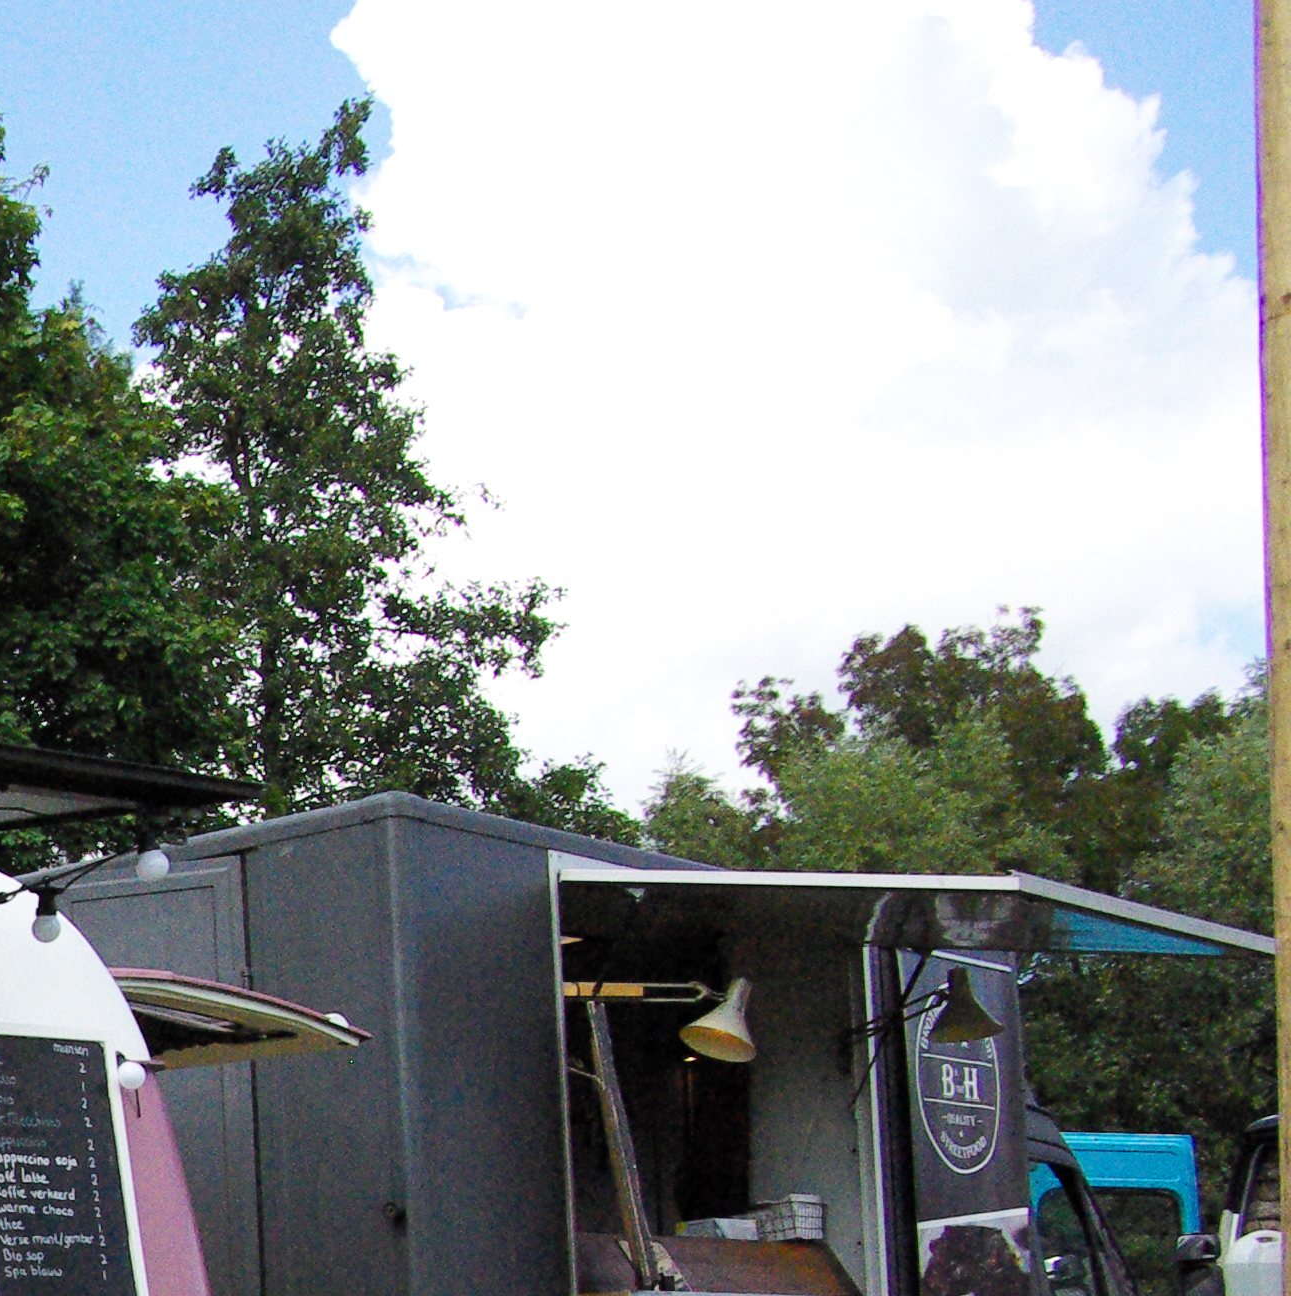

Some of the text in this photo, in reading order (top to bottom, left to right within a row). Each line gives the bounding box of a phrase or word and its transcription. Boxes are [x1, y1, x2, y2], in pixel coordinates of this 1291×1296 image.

[79, 1062, 87, 1074] 2
[81, 1097, 88, 1110] 2
[84, 1116, 93, 1128] 2
[87, 1138, 96, 1151] 2
[55, 1154, 78, 1171] soja
[88, 1156, 96, 1168] 2
[90, 1173, 98, 1186] 2
[30, 1187, 75, 1201] verkeerd
[93, 1190, 100, 1202] 2
[42, 1204, 75, 1217] choco
[94, 1206, 102, 1218] 2
[0, 1216, 25, 1231] thee
[99, 1234, 106, 1247] 2
[2, 1248, 108, 1265] Bio sap 2
[4, 1265, 27, 1280] Spa
[30, 1264, 63, 1277] blauw
